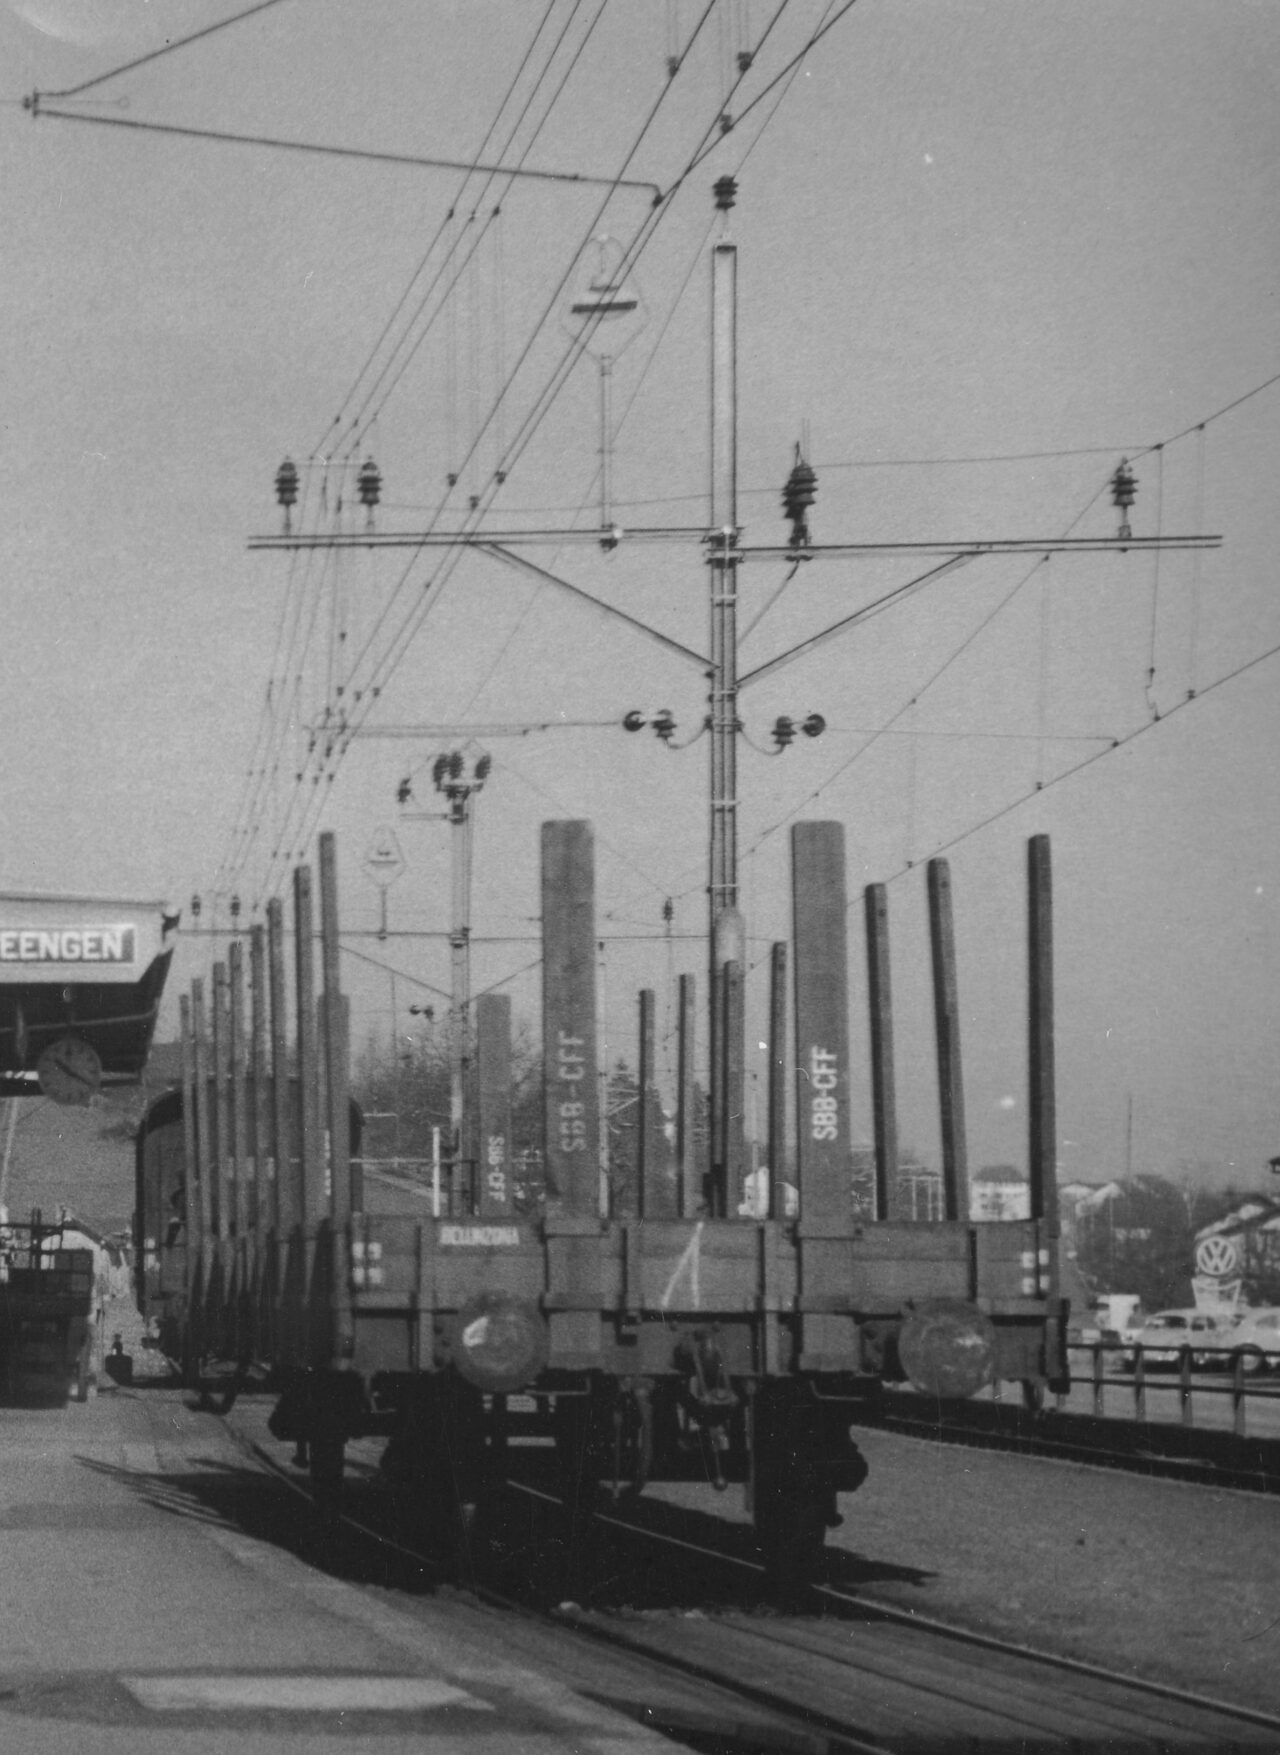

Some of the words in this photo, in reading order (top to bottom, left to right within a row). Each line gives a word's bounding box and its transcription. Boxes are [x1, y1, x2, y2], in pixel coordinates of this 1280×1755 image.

[558, 1030, 586, 1152] SBB-CFF
[811, 1045, 838, 1141] SBB-CFF
[1197, 1237, 1236, 1274] VW
